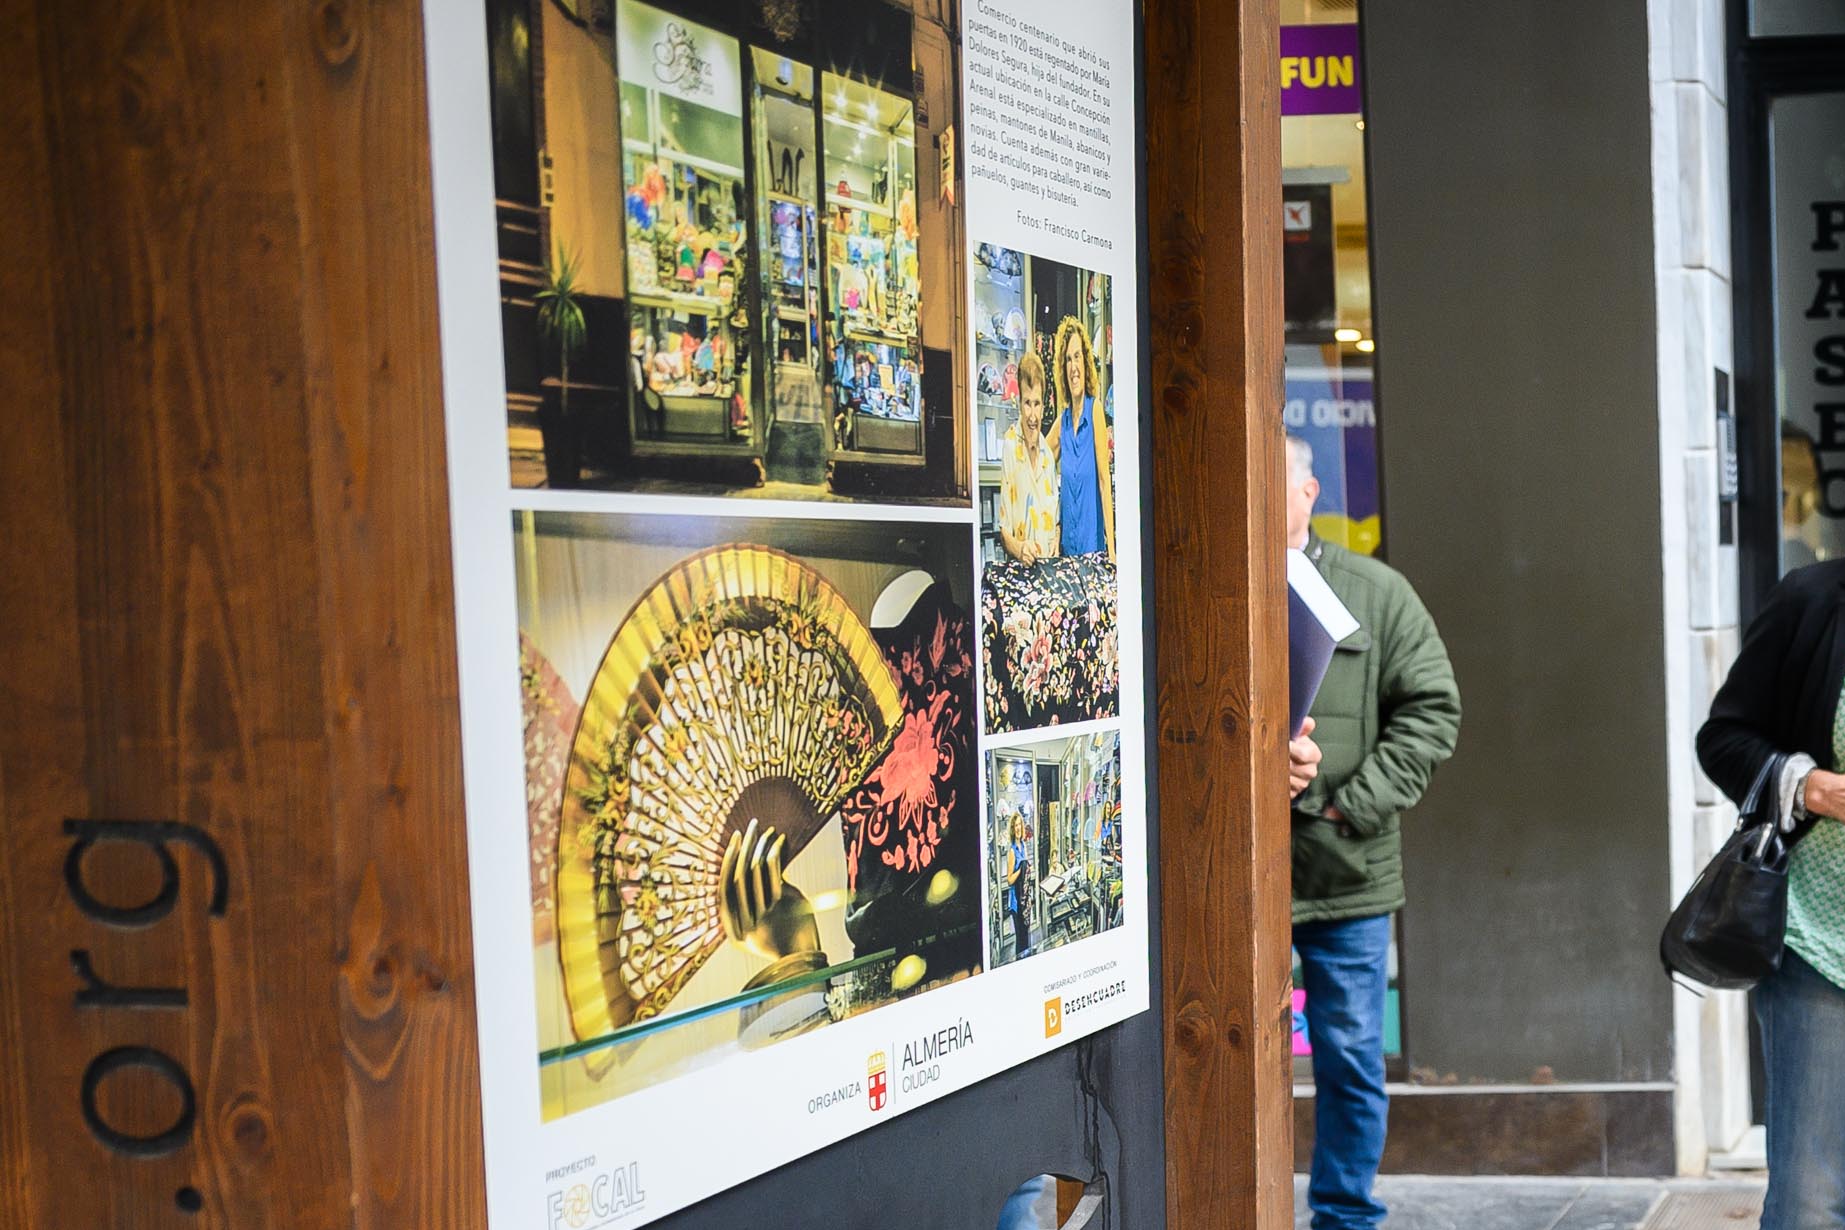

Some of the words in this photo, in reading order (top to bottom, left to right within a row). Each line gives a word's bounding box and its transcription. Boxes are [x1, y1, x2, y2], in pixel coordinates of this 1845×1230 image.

[969, 19, 997, 39] puertas
[999, 32, 1008, 44] en
[1010, 34, 1027, 52] 1920
[1045, 53, 1079, 75] regentado
[1080, 68, 1091, 80] por
[978, 0, 1016, 28] Comercio
[1019, 22, 1059, 47] centenario
[1062, 41, 1076, 54] que
[1078, 46, 1096, 64] abrió
[1099, 58, 1109, 70] sus
[969, 36, 999, 61] Dolores
[1002, 50, 1029, 75] Segura,
[1046, 70, 1057, 85] del
[1093, 89, 1101, 103] En
[969, 61, 993, 78] actual
[996, 69, 1031, 94] ubicación
[1034, 88, 1043, 98] en
[1053, 95, 1069, 109] calle
[1071, 99, 1110, 125] Concepción
[1280, 56, 1354, 89] FUN
[969, 78, 996, 99] Arenal
[1017, 100, 1066, 127] especializado
[1068, 121, 1077, 131] en
[1001, 114, 1036, 135] mantones
[1039, 125, 1048, 139] de
[1050, 129, 1074, 151] Manila,
[1077, 140, 1105, 160] abanicos
[1001, 131, 1028, 152] Cuenta
[1030, 143, 1058, 163] además
[1060, 156, 1073, 167] con
[1075, 161, 1090, 173] gran
[971, 141, 986, 157] dad
[988, 147, 998, 161] de
[1032, 165, 1048, 178] para
[1094, 186, 1111, 199] como
[972, 165, 1008, 187] pañuelos,
[1011, 178, 1039, 195] guantes
[1017, 210, 1041, 229] Fotos:
[1044, 218, 1079, 240] Francisco
[1082, 229, 1112, 250] Carmona
[1048, 1008, 1058, 1028] D
[1064, 980, 1126, 1015] DESENCUADRE
[902, 1017, 974, 1071] ALMERÍA
[808, 1081, 862, 1114] ORGANIZA
[902, 1065, 941, 1093] CIUDAD
[545, 1154, 596, 1184] PROYECTO
